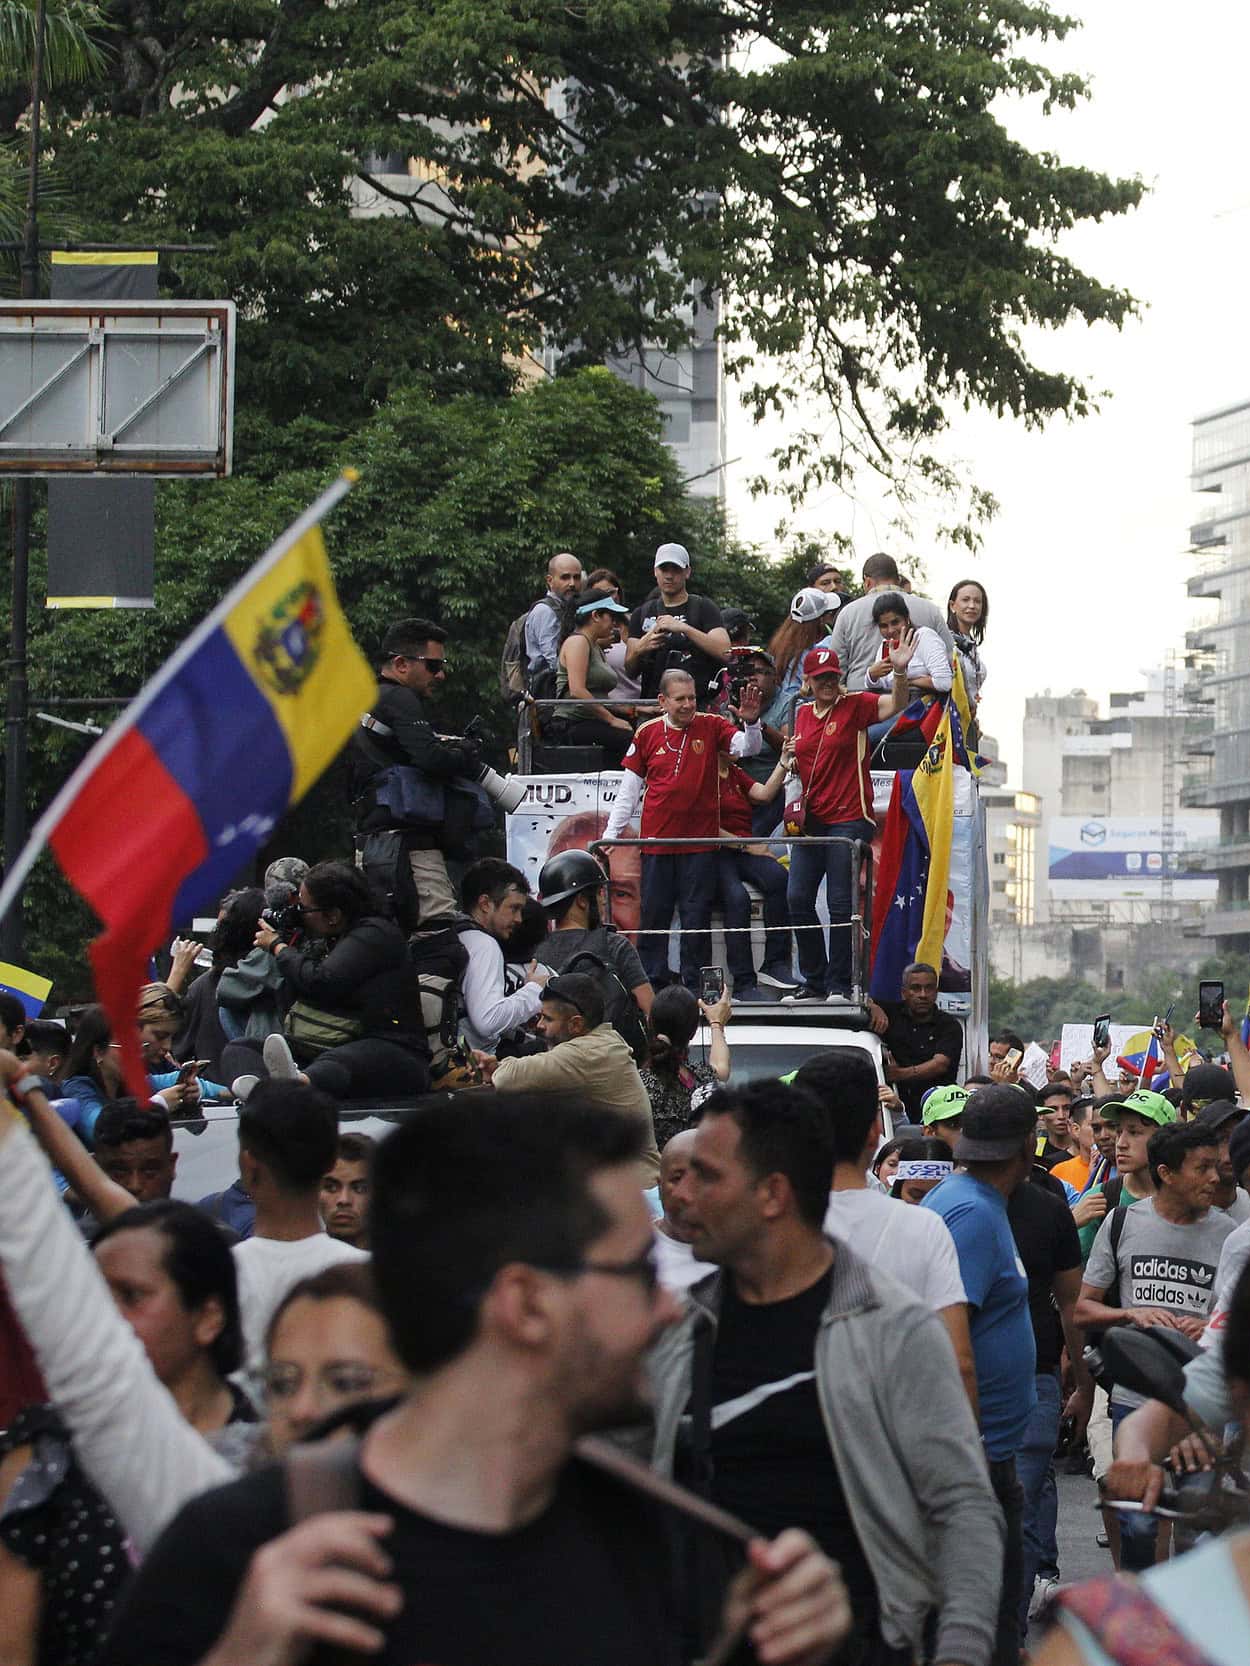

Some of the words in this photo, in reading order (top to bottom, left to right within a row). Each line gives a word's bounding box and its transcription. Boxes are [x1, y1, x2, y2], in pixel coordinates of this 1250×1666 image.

[872, 779, 891, 787] Mes
[1129, 1093, 1150, 1102] DC
[911, 1164, 951, 1172] CON
[1134, 1258, 1188, 1281] adidas
[1135, 1284, 1185, 1305] adidas
